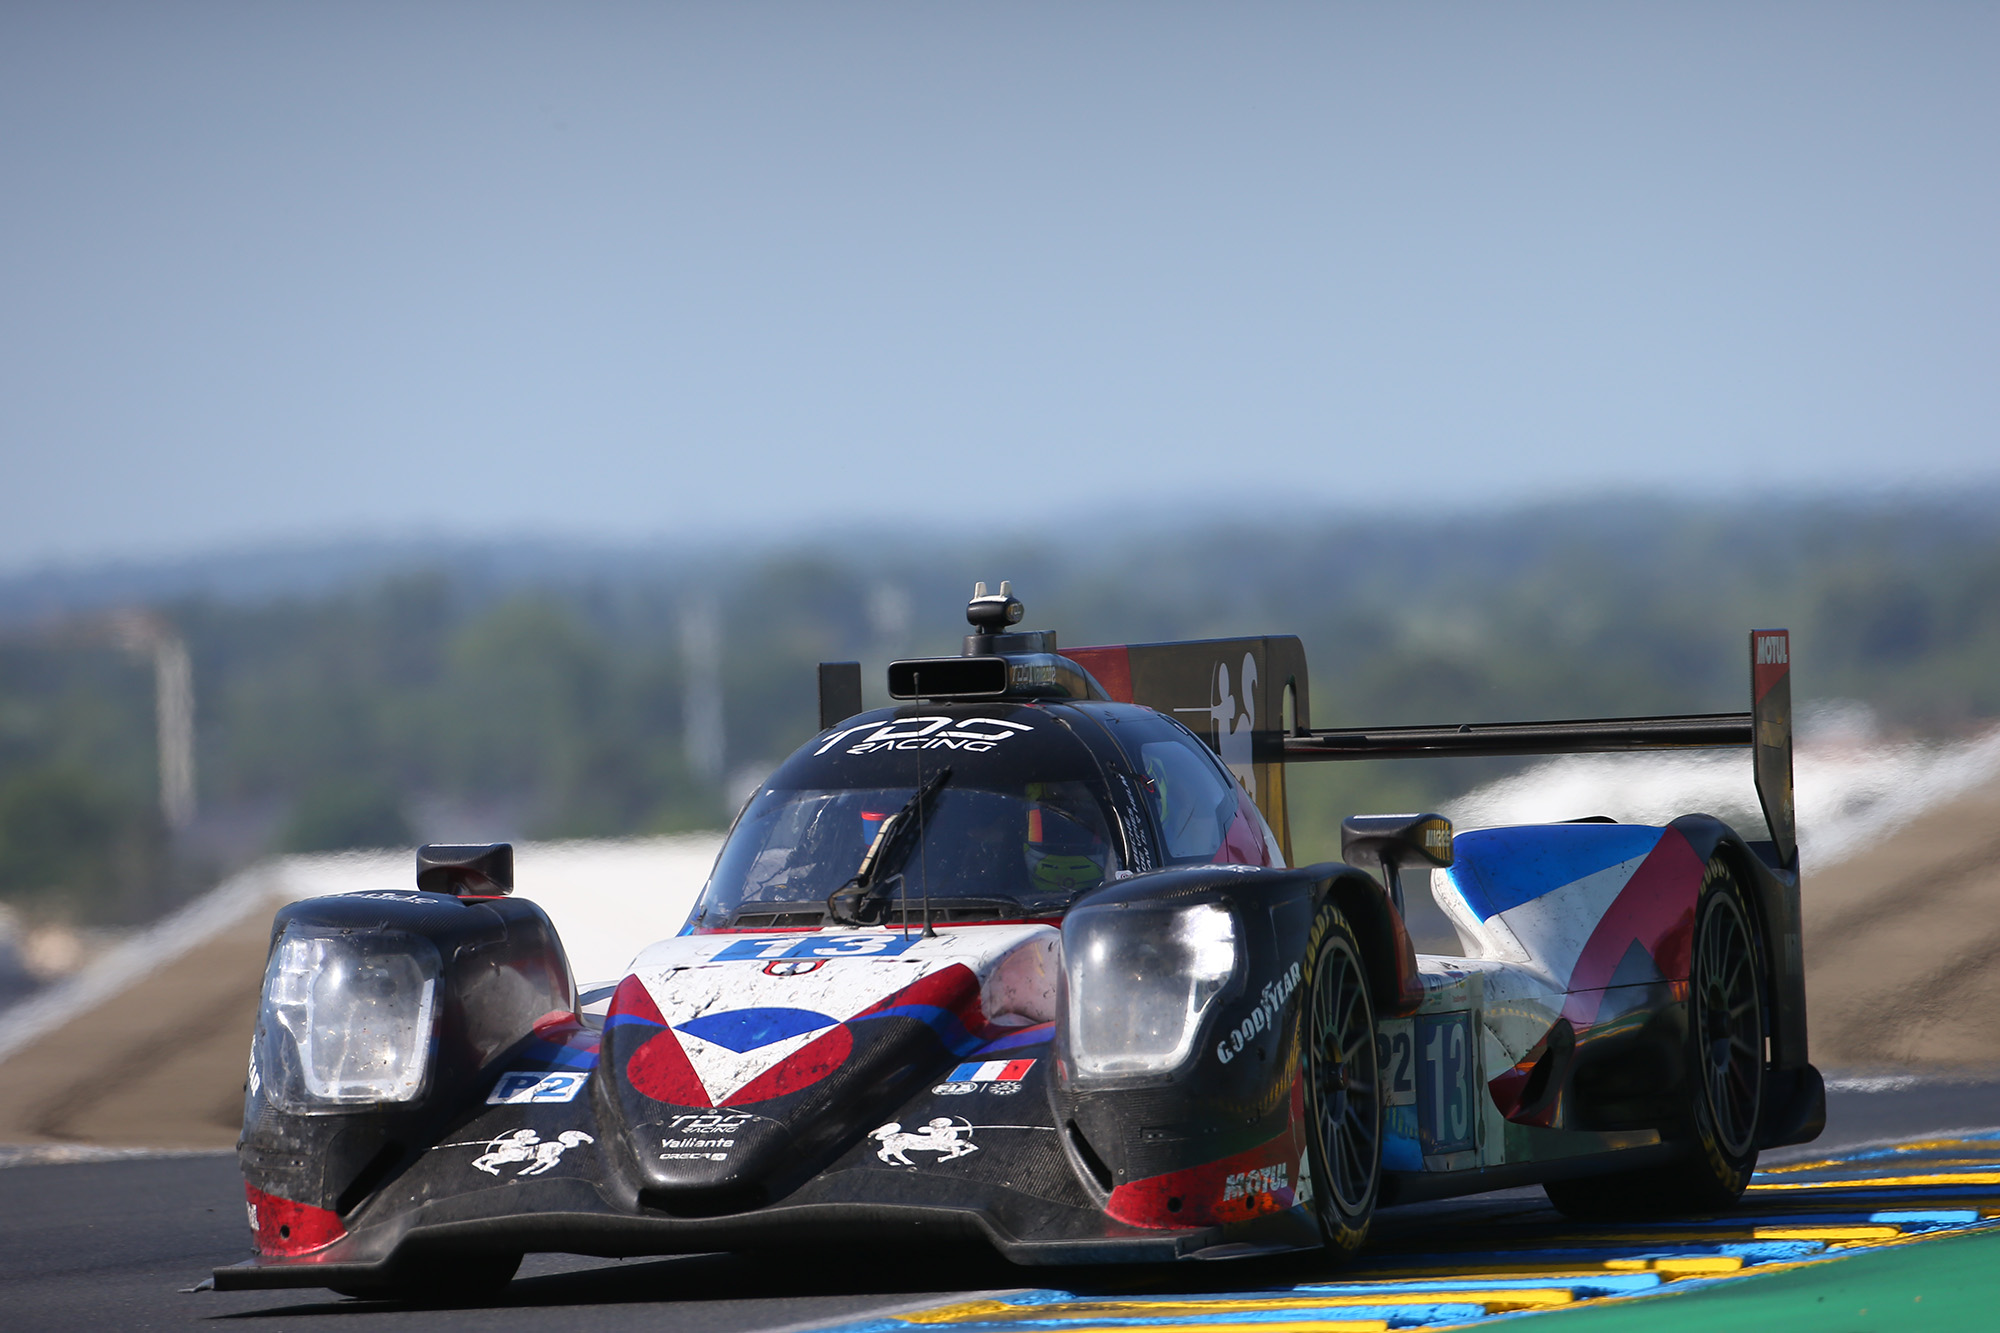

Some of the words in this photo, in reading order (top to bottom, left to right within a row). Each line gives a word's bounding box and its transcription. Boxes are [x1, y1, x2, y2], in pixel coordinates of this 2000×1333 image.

[1757, 636, 1787, 664] MOTUL
[814, 717, 1035, 756] TDS
[846, 737, 998, 754] RACING
[750, 934, 898, 958] 13
[1216, 961, 1302, 1064] GOODYEAR
[497, 1075, 576, 1099] P2
[1426, 1022, 1468, 1141] 13
[668, 1114, 754, 1128] TDS
[1223, 1162, 1288, 1202] MOTUL
